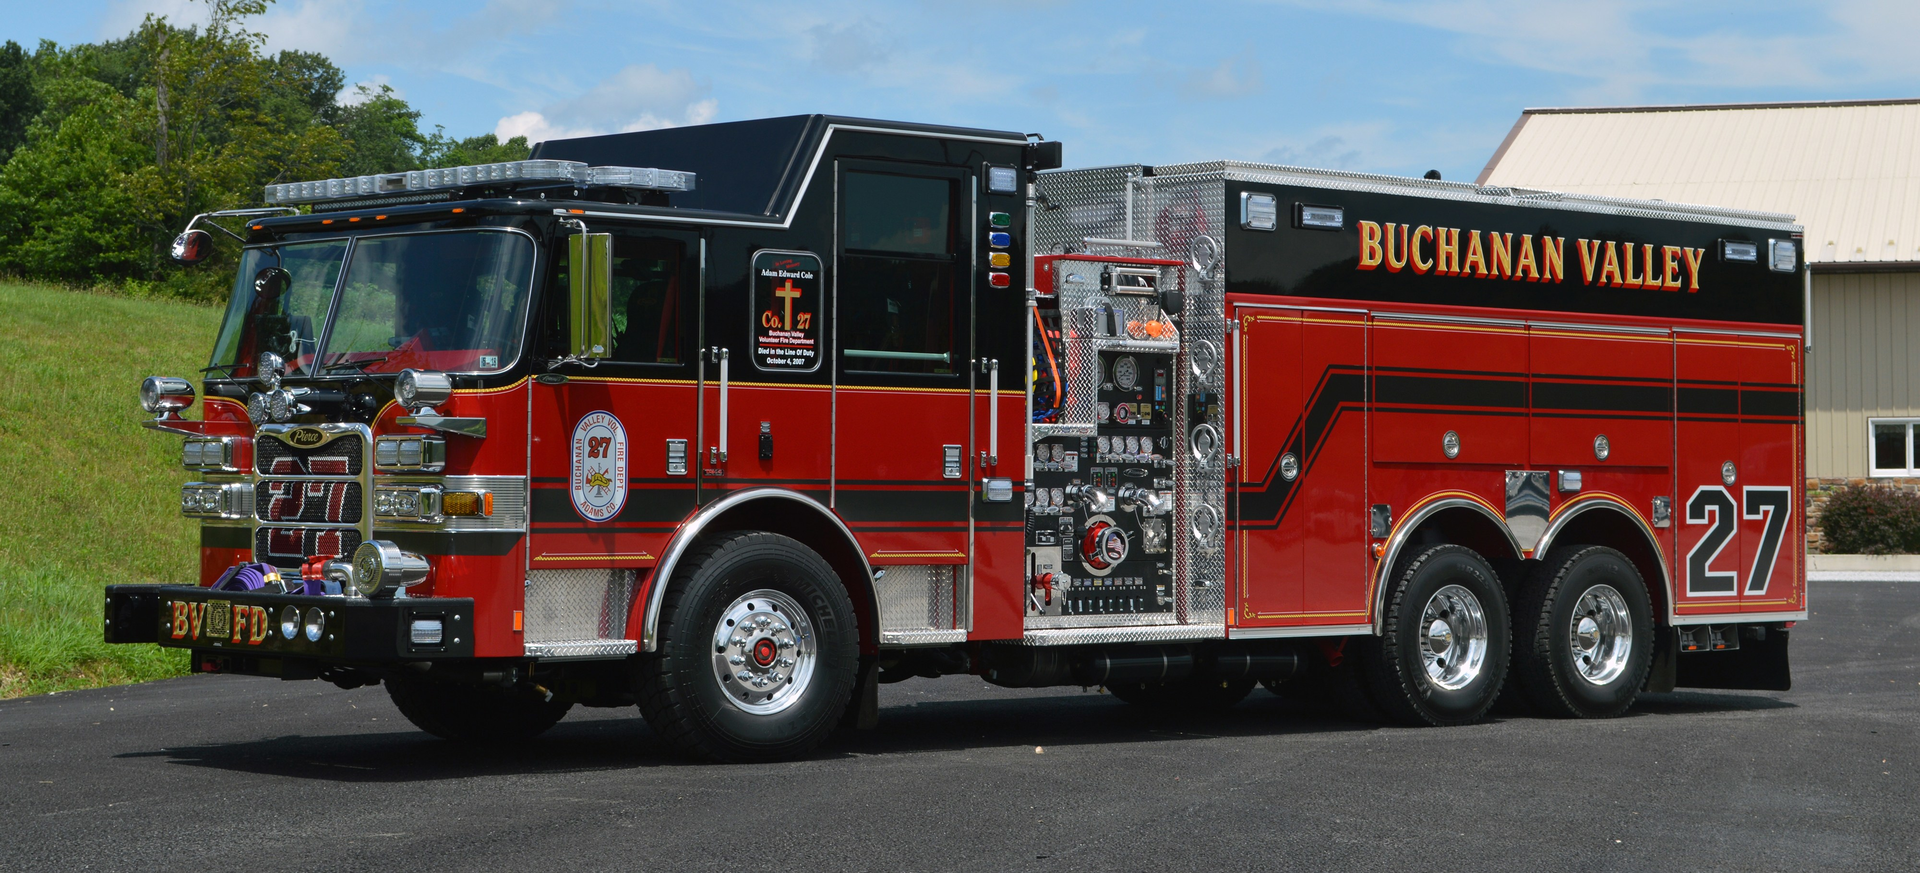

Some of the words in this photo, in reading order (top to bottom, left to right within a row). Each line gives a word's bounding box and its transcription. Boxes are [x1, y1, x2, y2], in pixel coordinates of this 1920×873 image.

[1356, 219, 1565, 284] BUCHANAN
[1575, 238, 1706, 294] VALLEY
[761, 268, 778, 277] Adam
[778, 270, 800, 278] Edward
[800, 272, 814, 280] Cole
[762, 310, 782, 328] Co.
[796, 312, 812, 330] 27
[580, 414, 606, 432] VALLEY
[607, 418, 619, 436] VOL.
[294, 429, 318, 443] Pierce
[588, 436, 612, 459] 27
[616, 442, 624, 462] FIRE
[574, 438, 582, 491] BUCHANAN
[616, 466, 624, 492] DEPT.
[580, 500, 604, 518] ADAMS
[606, 502, 618, 514] CO.
[1685, 484, 1792, 598] 27
[795, 575, 839, 670] MICHELIN
